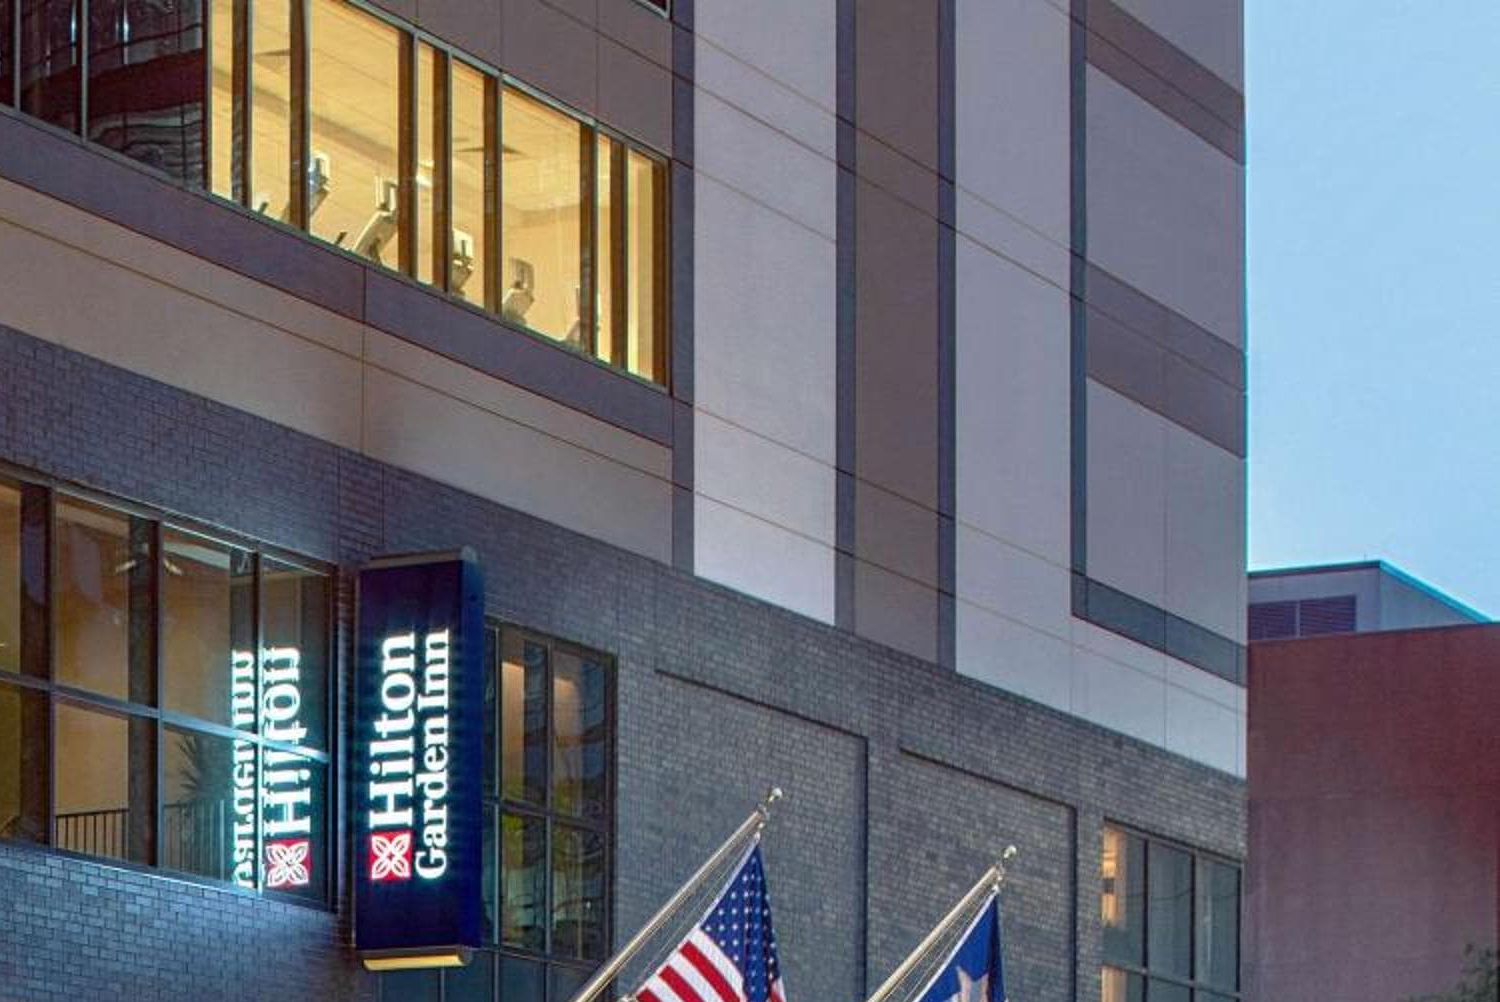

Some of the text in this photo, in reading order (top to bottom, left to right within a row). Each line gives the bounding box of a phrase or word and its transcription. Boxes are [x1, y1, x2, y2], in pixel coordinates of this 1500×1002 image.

[369, 631, 416, 829] Hilton
[414, 628, 449, 880] Garden Inn
